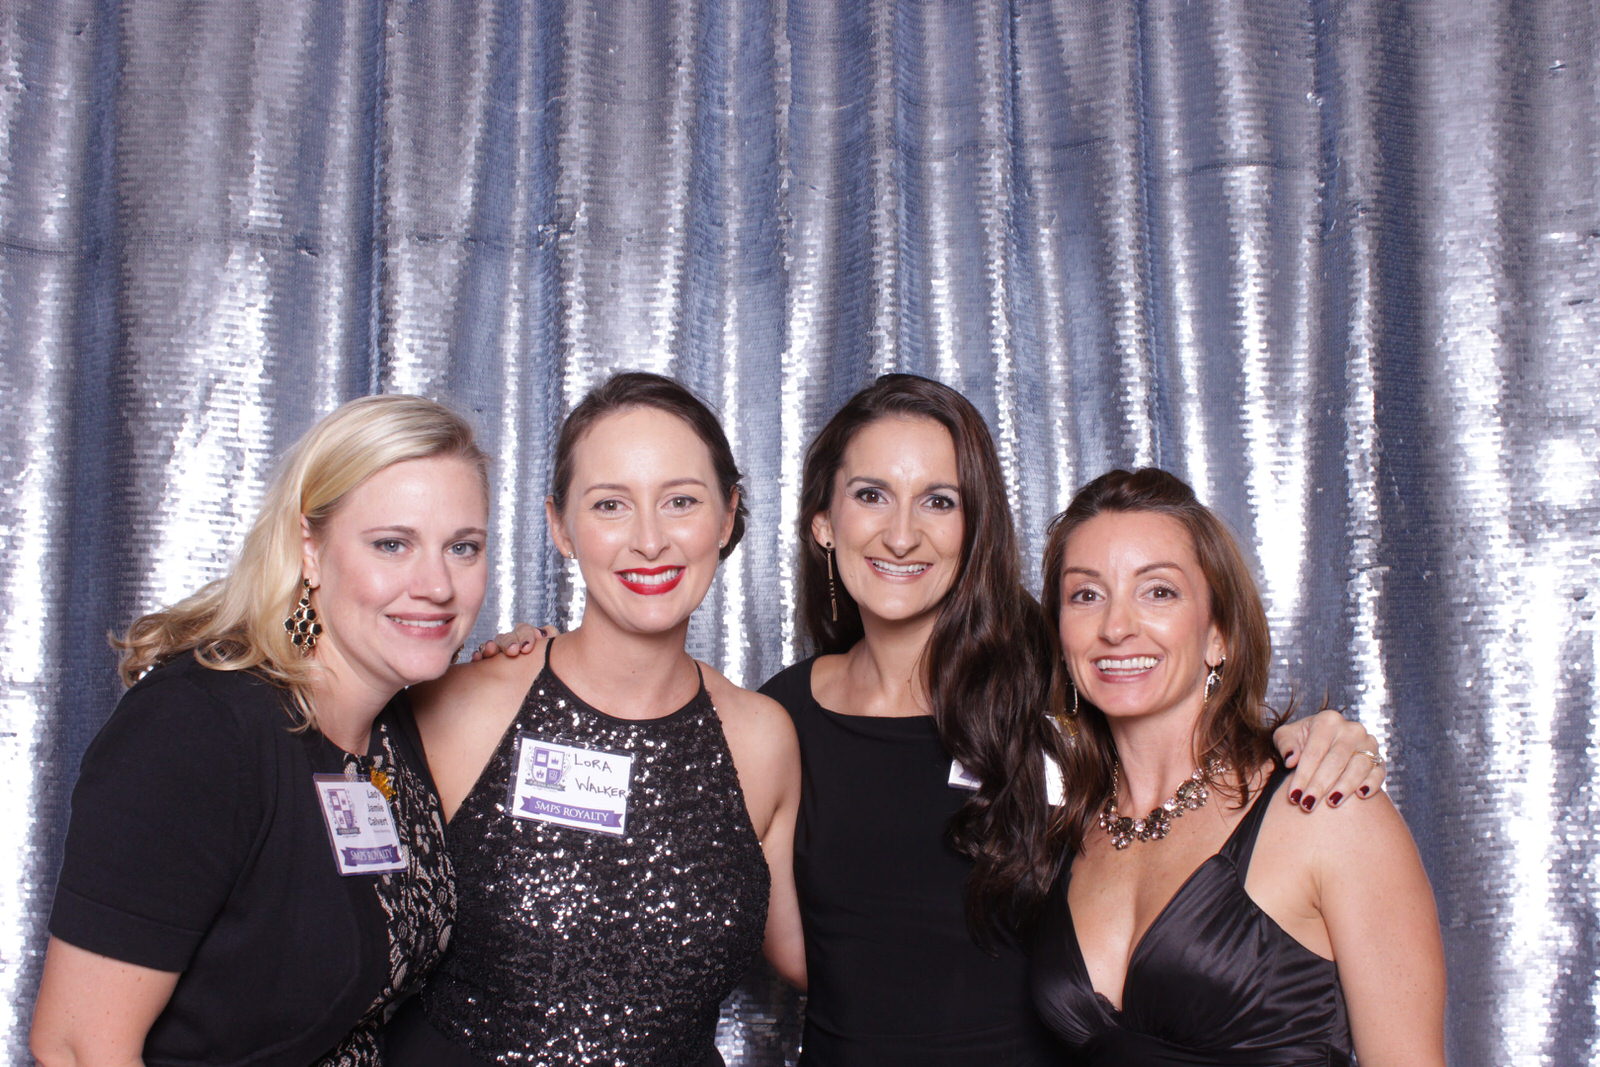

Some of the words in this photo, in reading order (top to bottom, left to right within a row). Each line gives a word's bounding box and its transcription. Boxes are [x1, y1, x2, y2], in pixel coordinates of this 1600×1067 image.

[575, 775, 628, 800] WALKER
[367, 789, 380, 800] Lady
[368, 804, 384, 813] Jamie
[534, 801, 561, 814] SMPS
[563, 807, 609, 821] ROYALTY
[368, 817, 388, 826] Calvert
[350, 850, 367, 861] SMPS
[367, 848, 393, 861] ROYALTY
